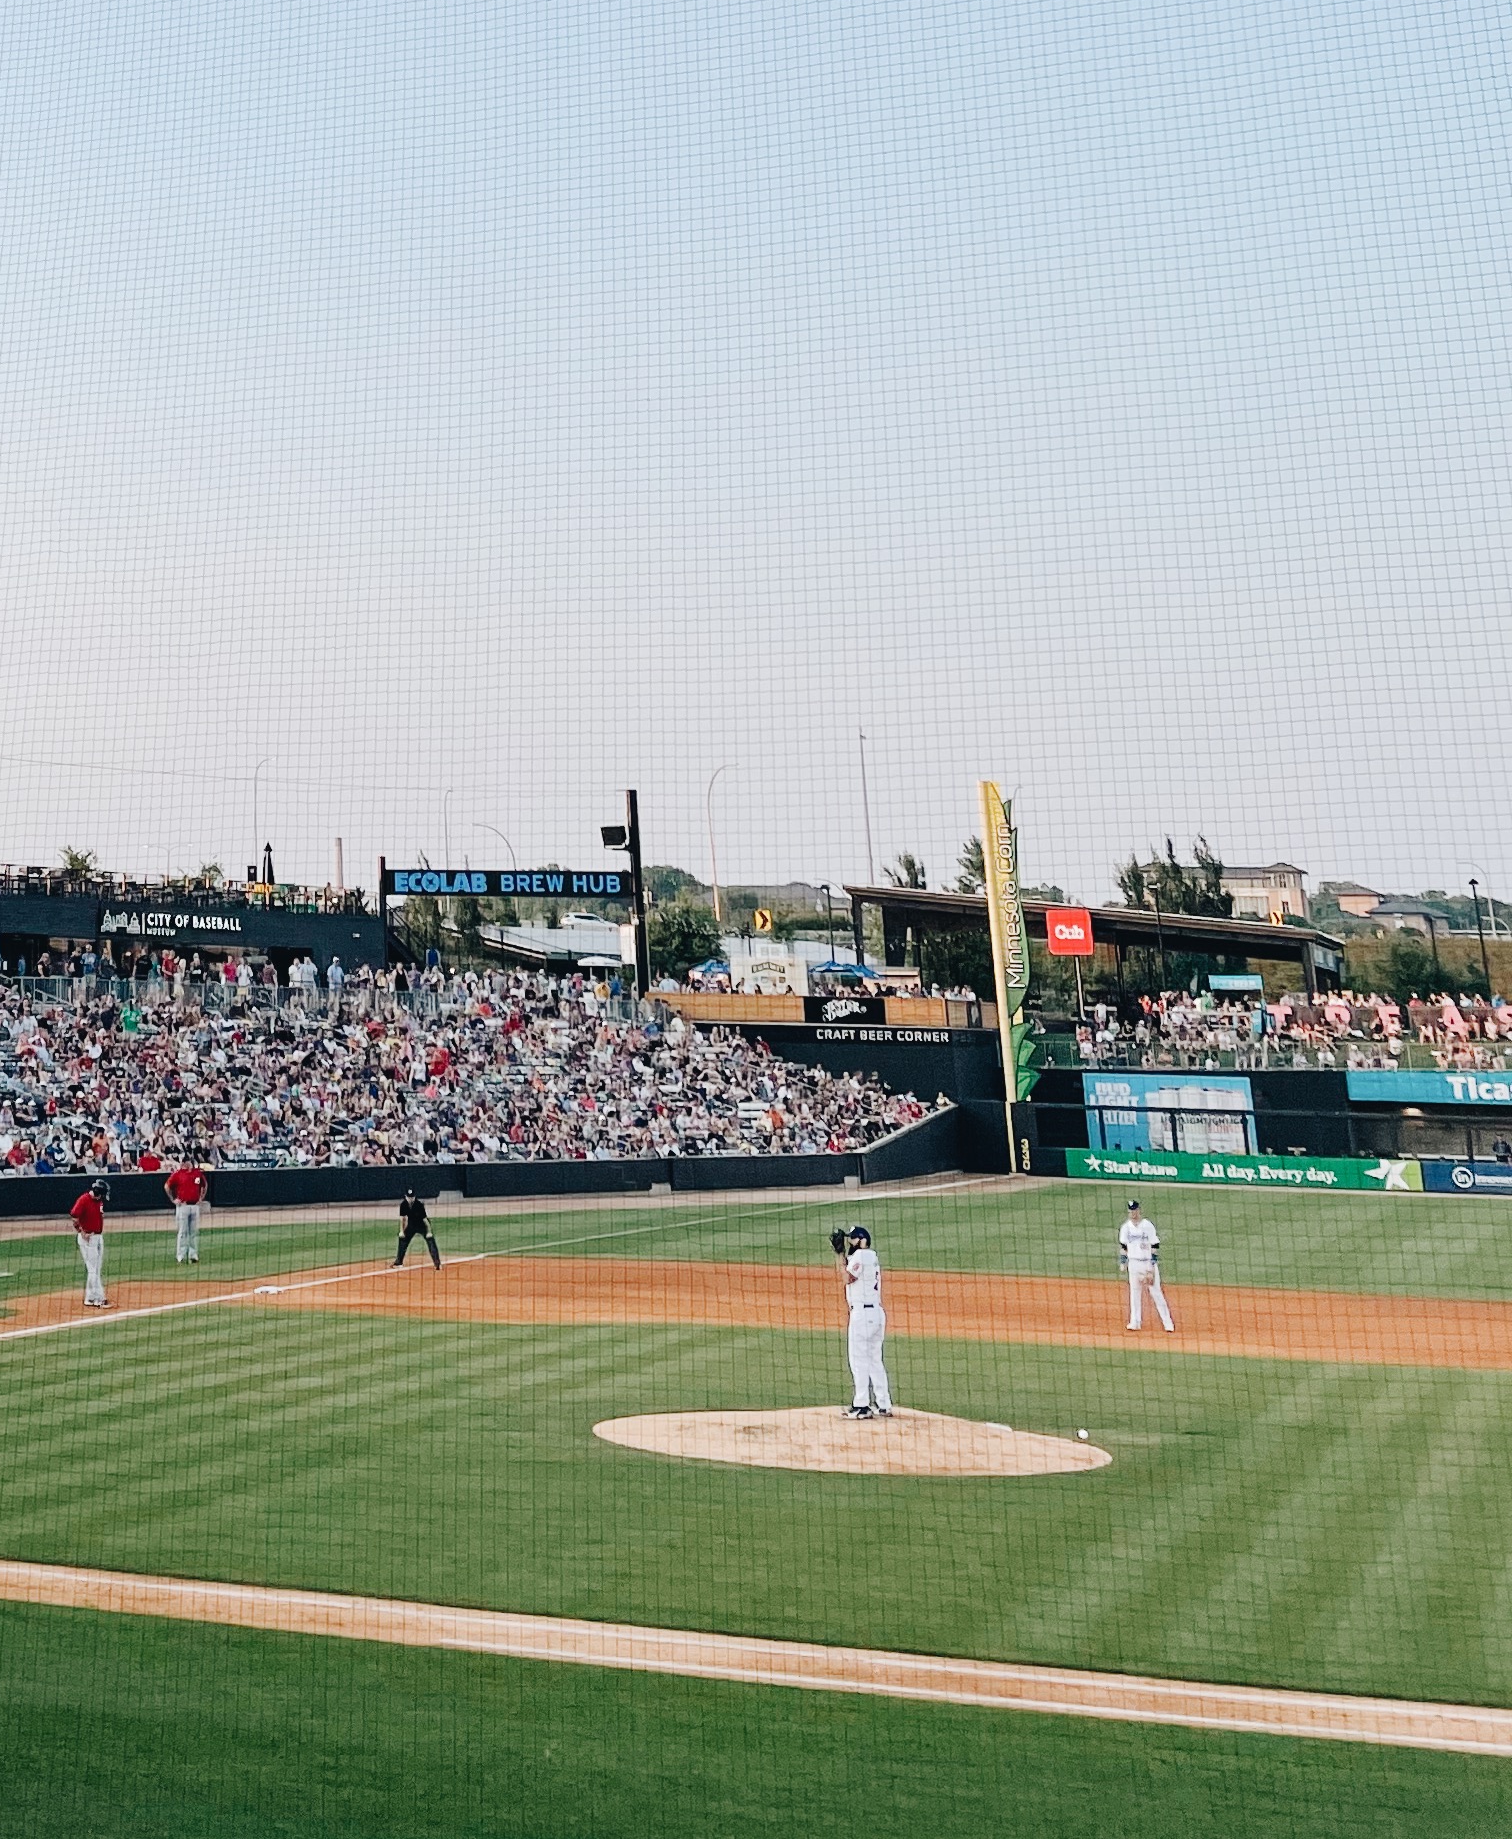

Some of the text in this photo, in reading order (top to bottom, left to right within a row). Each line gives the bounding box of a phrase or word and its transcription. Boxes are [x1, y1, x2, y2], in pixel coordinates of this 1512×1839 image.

[394, 872, 621, 894] ECOLAB BREW HUB
[996, 822, 1026, 989] Minnesota Corn
[147, 913, 242, 931] CITY OF BASEBALL
[1054, 925, 1085, 940] Cub
[816, 1028, 950, 1043] CRAFT BEER CORNER
[1095, 1082, 1131, 1096] BUD
[1089, 1094, 1139, 1107] LIGHT
[1021, 1138, 1030, 1171] 330
[1103, 1159, 1178, 1177] StarTribune
[1202, 1163, 1338, 1185] All day. Every day.
